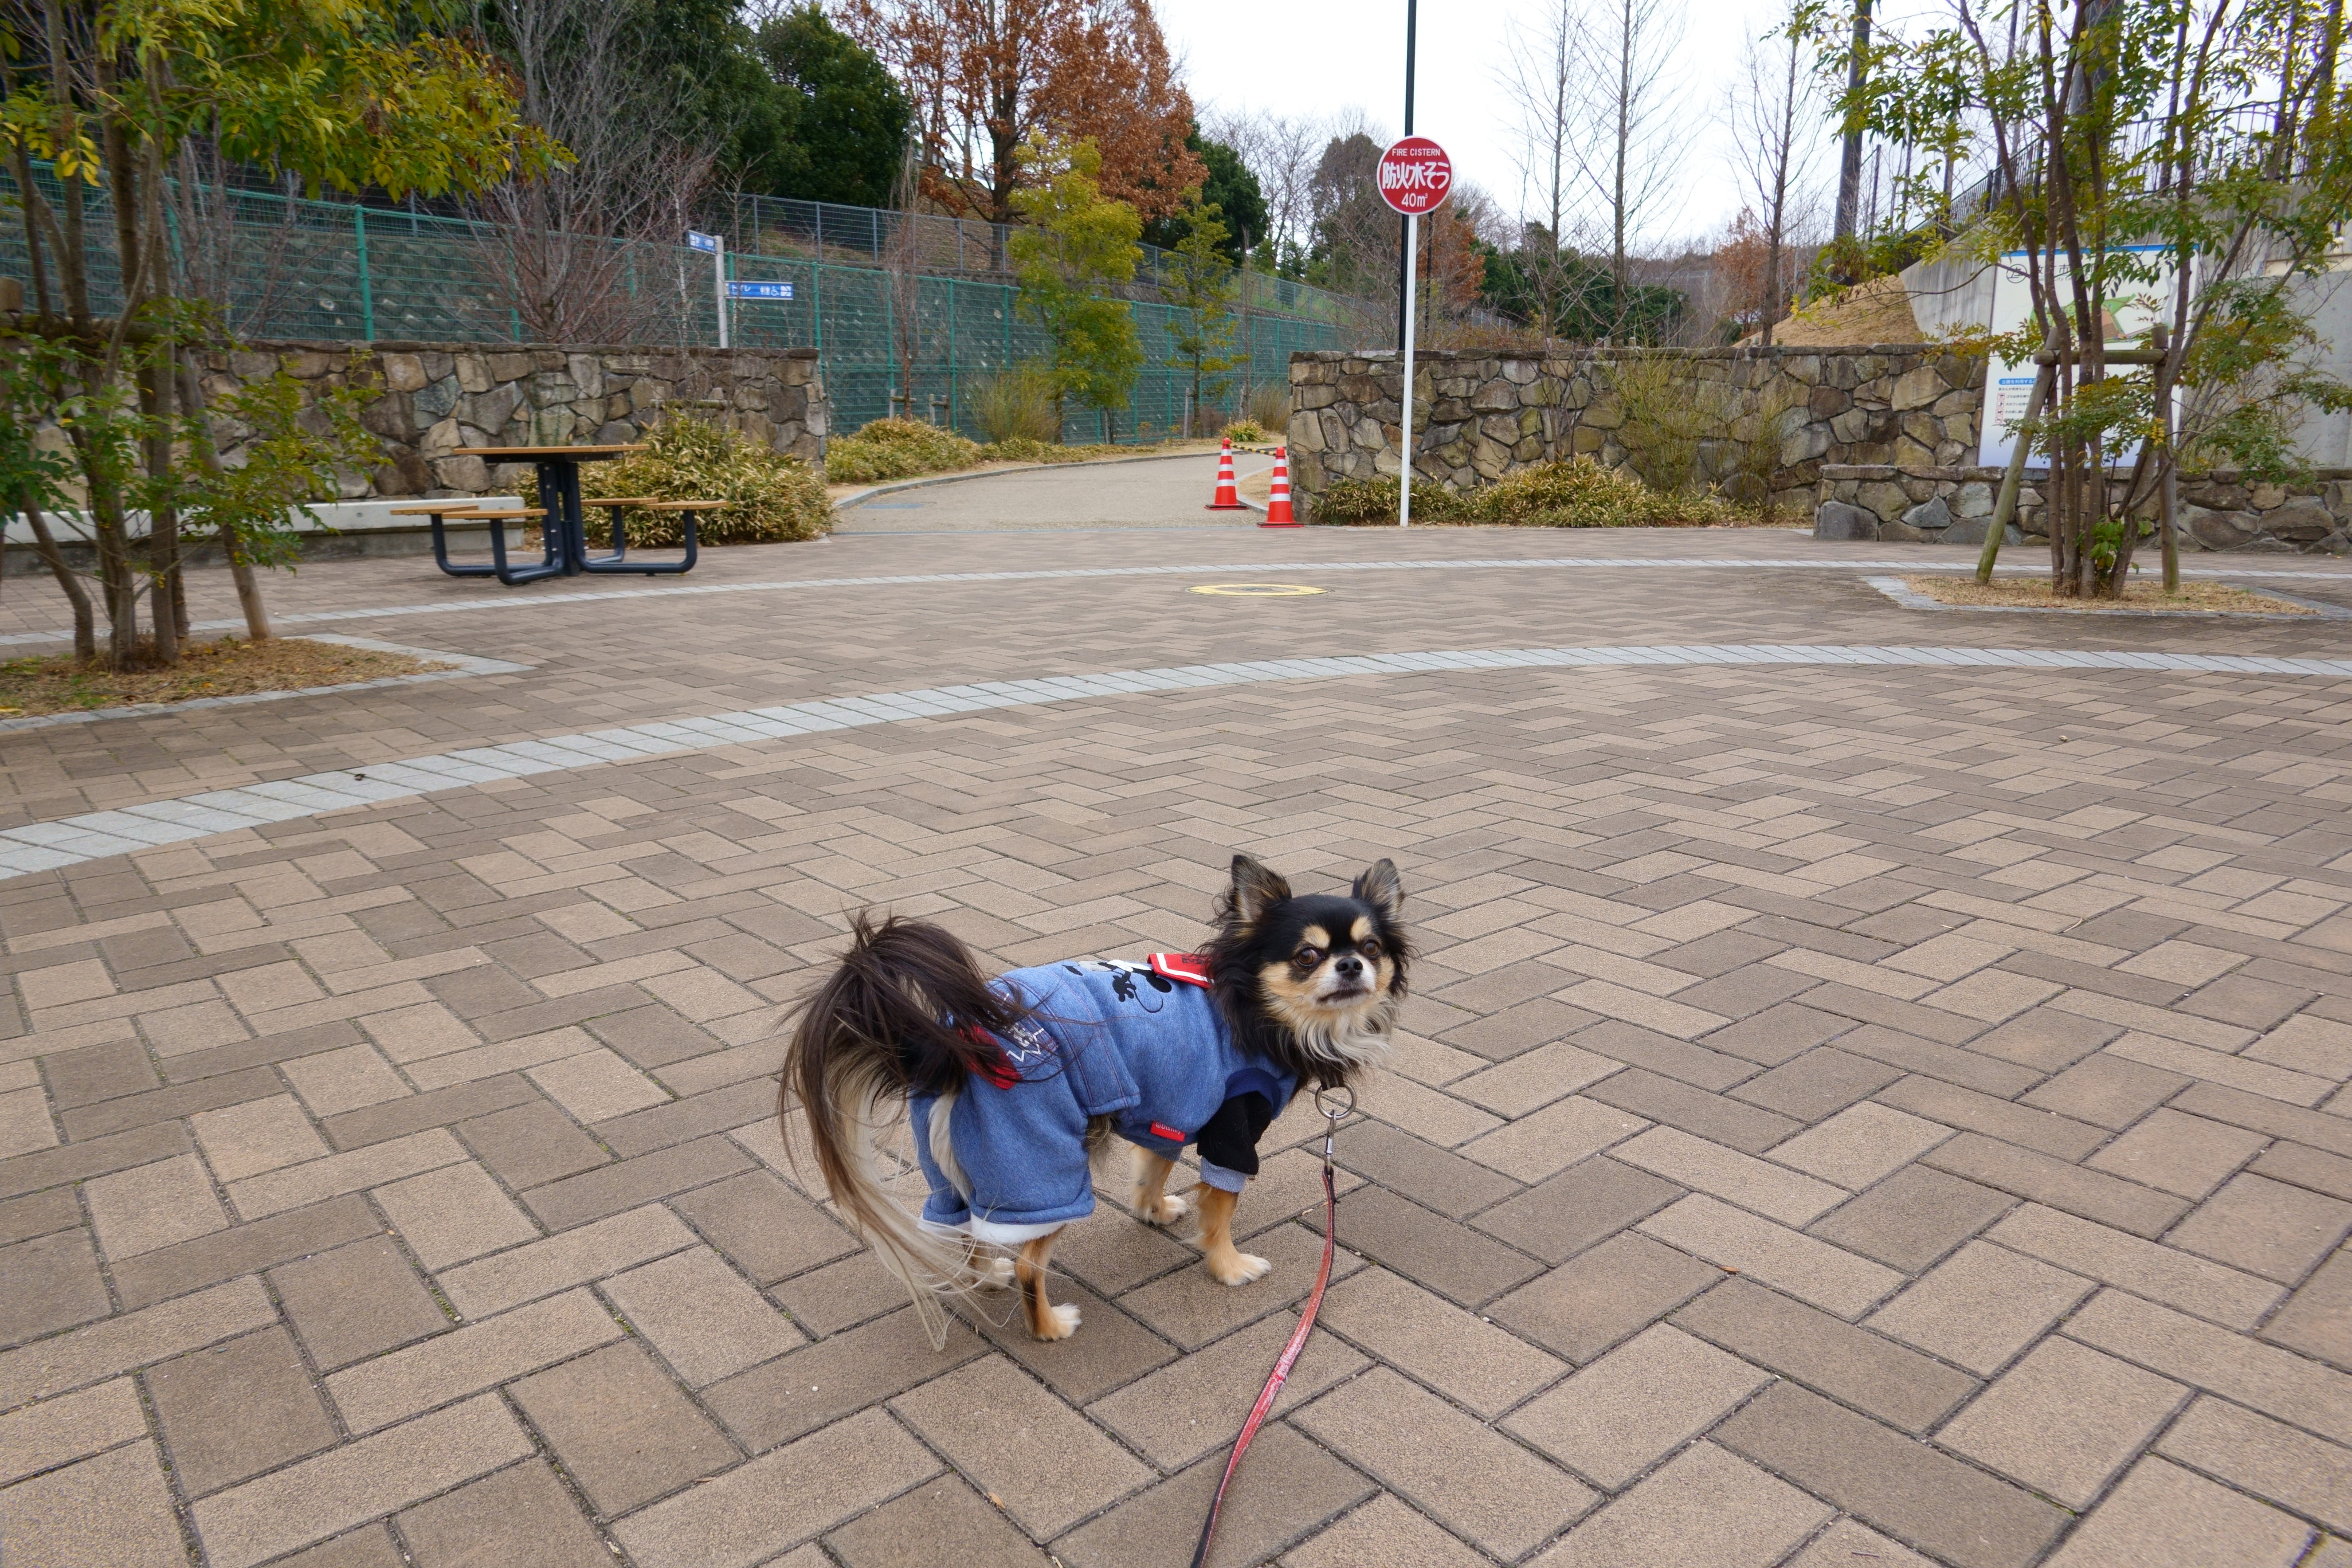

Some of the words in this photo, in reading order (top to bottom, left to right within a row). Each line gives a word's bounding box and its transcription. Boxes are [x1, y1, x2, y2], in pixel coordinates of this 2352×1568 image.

[1382, 162, 1449, 190] 防火水そう
